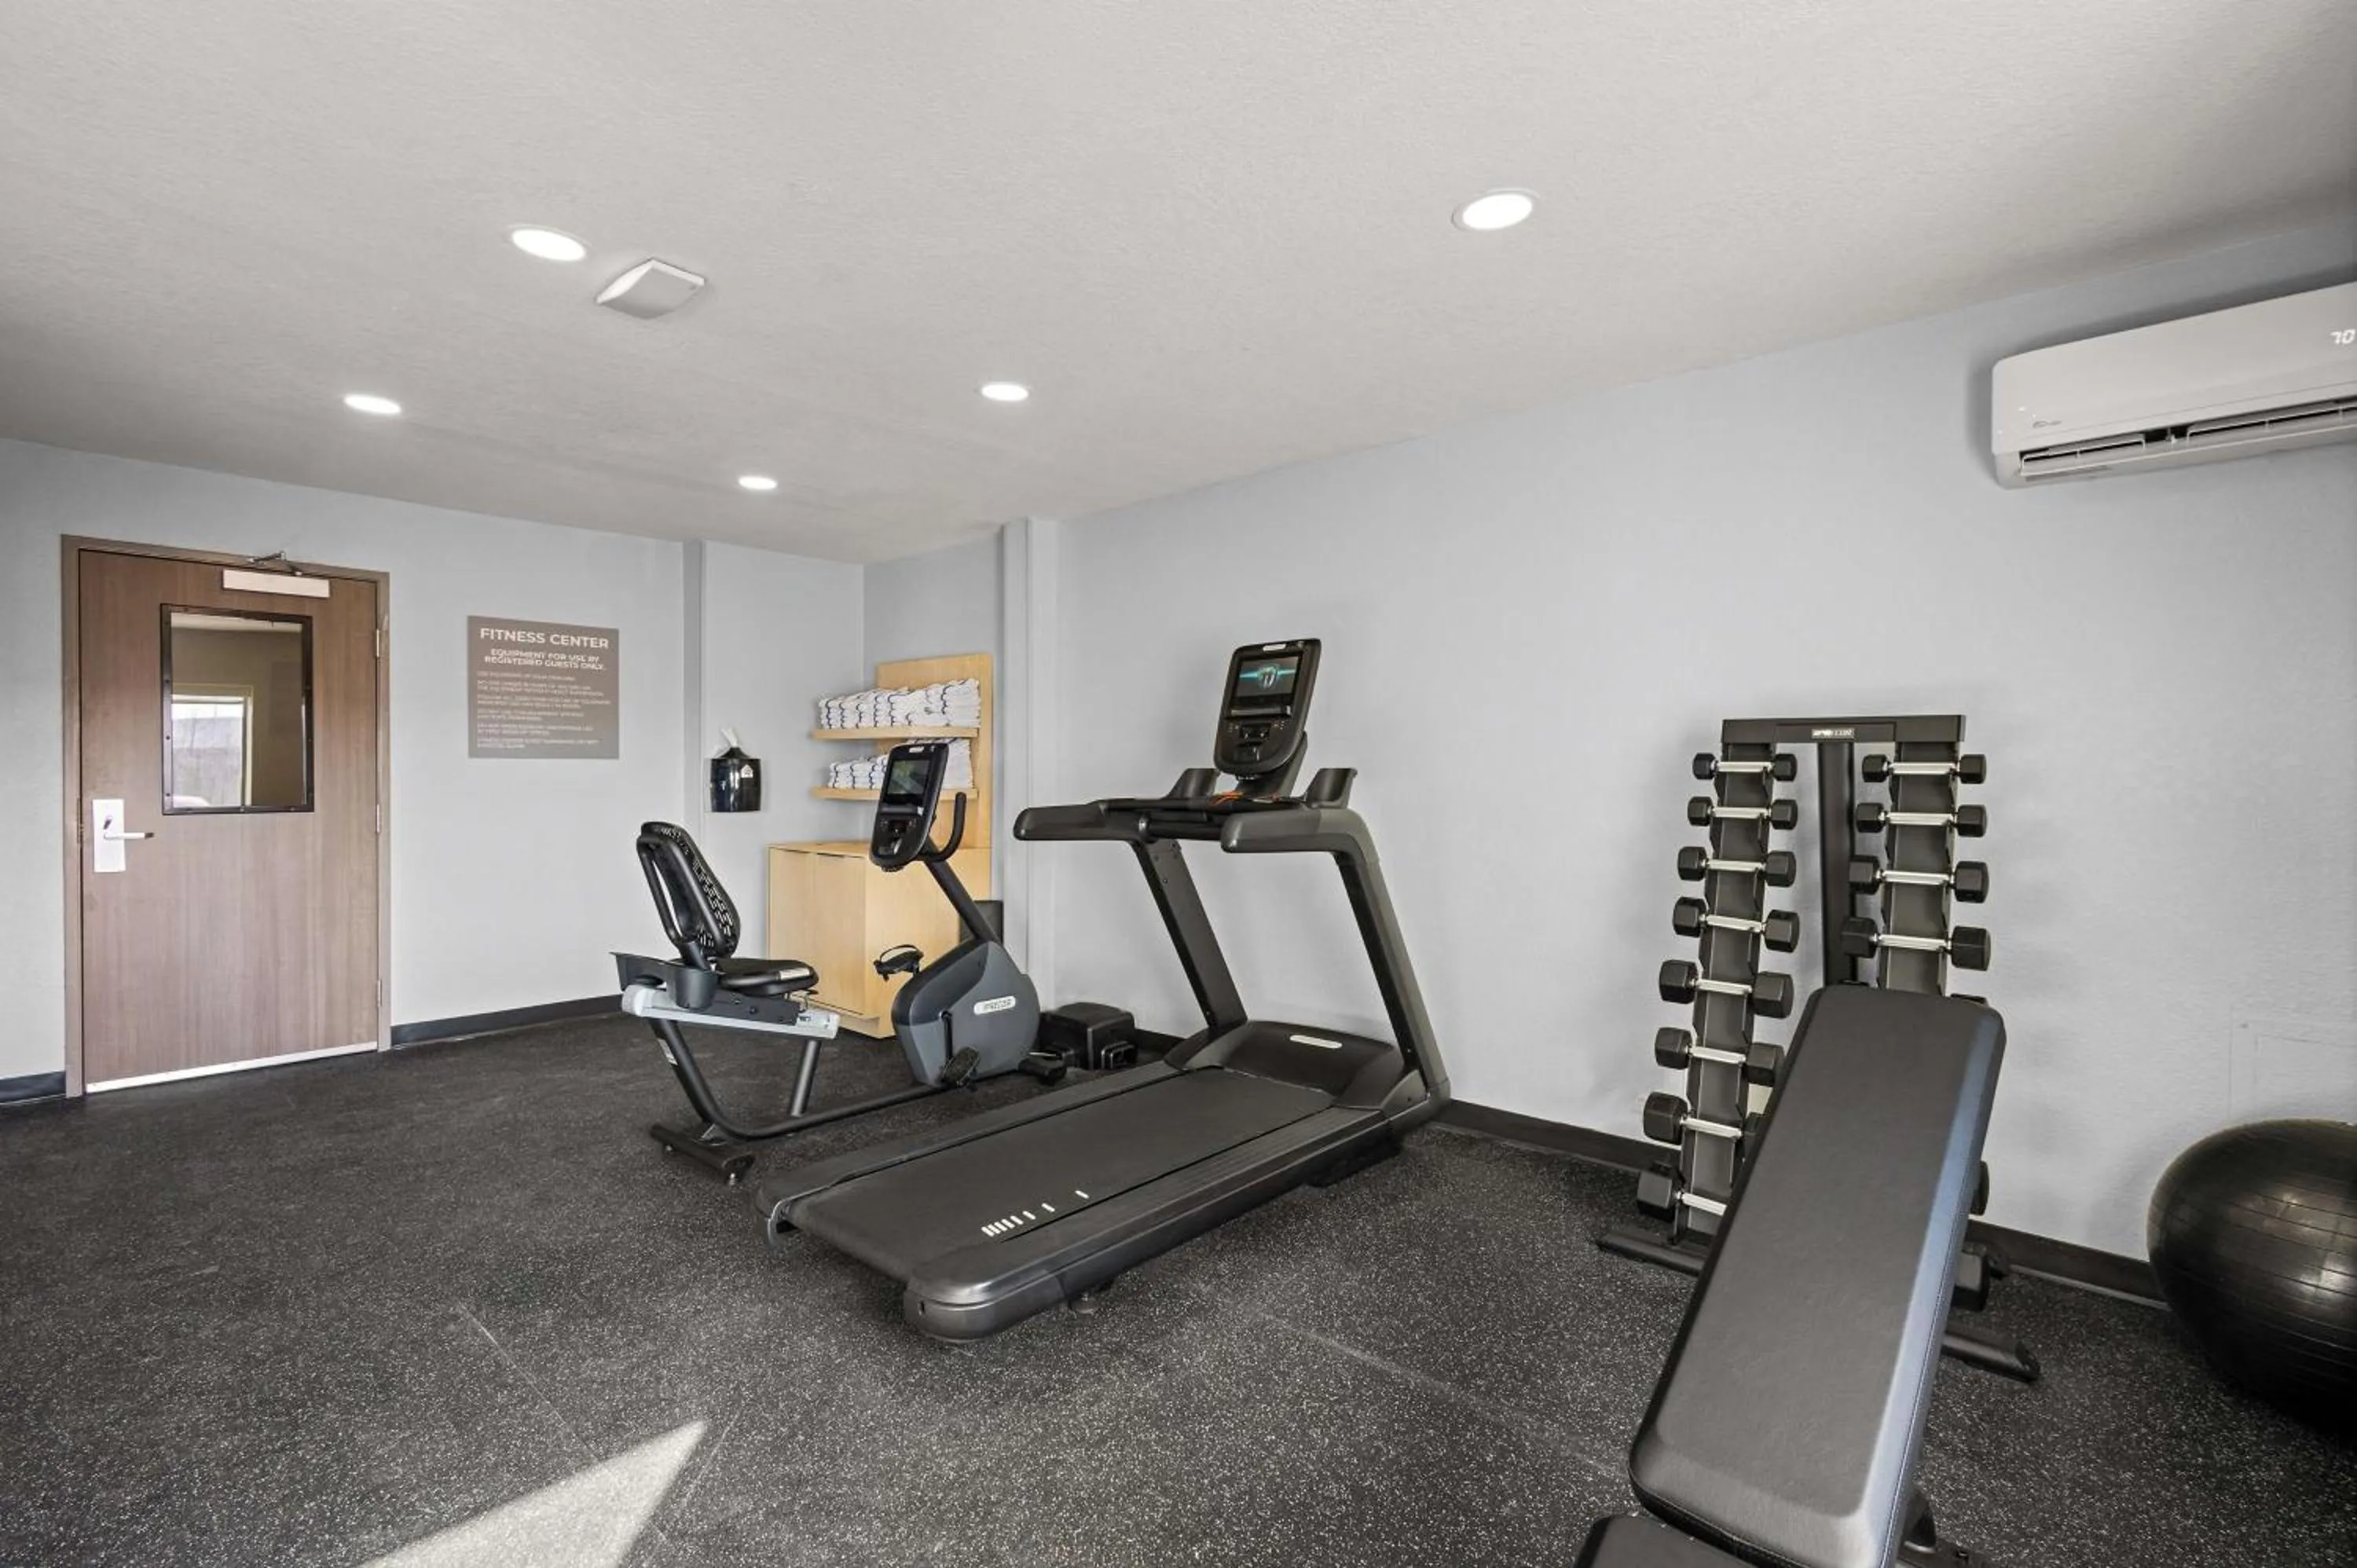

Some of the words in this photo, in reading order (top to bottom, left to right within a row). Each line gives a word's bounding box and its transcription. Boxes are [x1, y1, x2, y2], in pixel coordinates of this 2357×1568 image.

[2330, 329, 2355, 344] 70
[480, 628, 546, 643] FITNESS
[550, 634, 609, 649] CENTER
[490, 648, 544, 659] EQUIPMENT
[548, 653, 566, 661] FOR
[484, 656, 543, 666] REGISTERED
[544, 660, 579, 669] GUESTS
